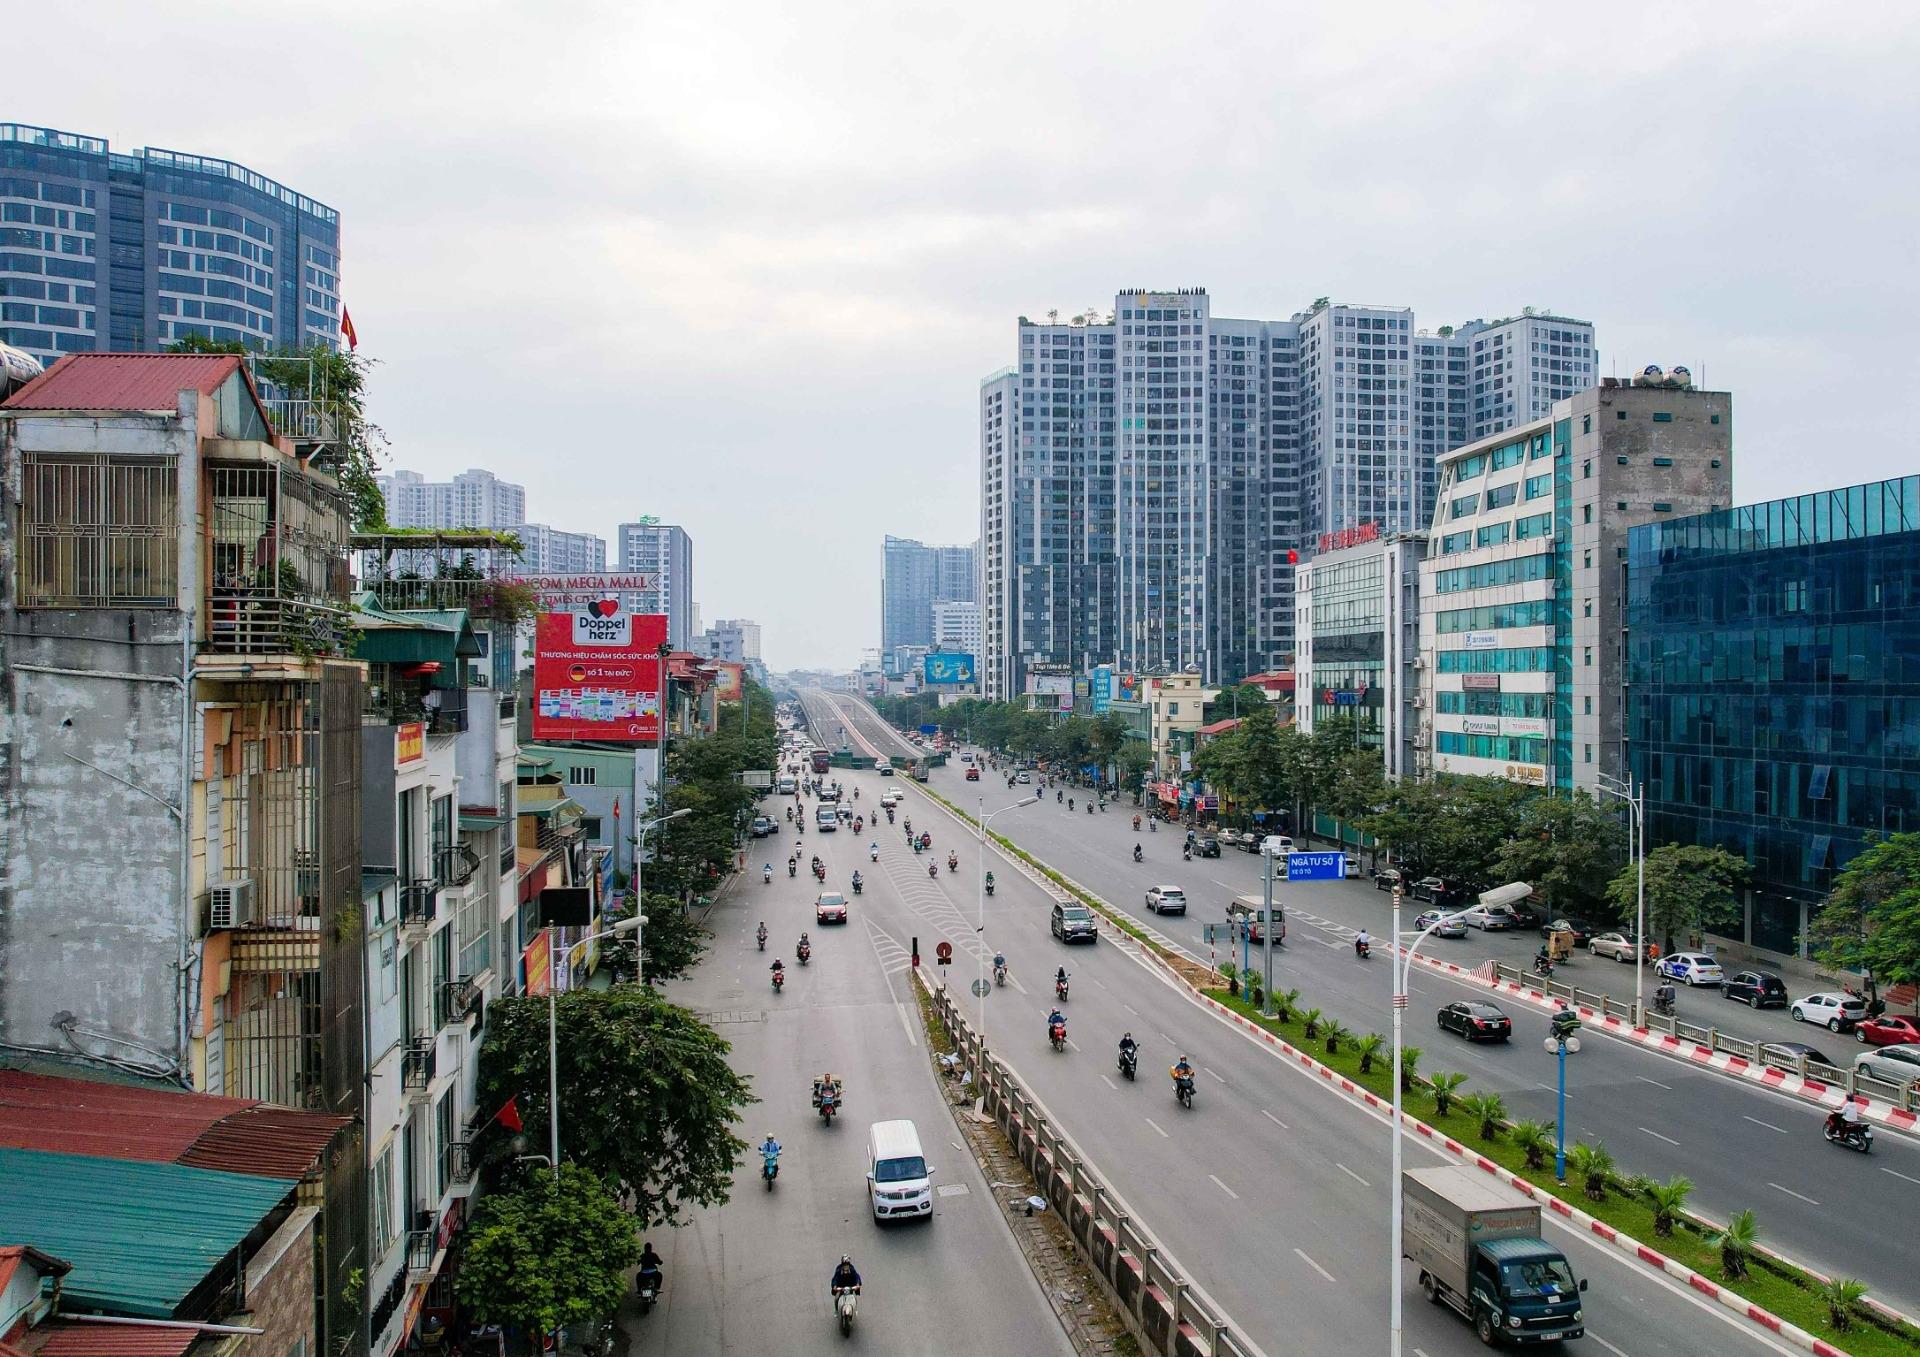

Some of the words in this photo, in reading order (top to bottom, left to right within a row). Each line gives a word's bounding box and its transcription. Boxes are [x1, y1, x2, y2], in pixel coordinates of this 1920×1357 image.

[566, 576, 606, 589] MEGA
[609, 576, 647, 589] MALL
[579, 617, 625, 631] Doppel
[588, 629, 617, 640] herz
[597, 668, 603, 676] 1
[1291, 856, 1309, 866] NGÃ
[1310, 857, 1322, 866] TƯ
[1322, 855, 1334, 866] SỞ
